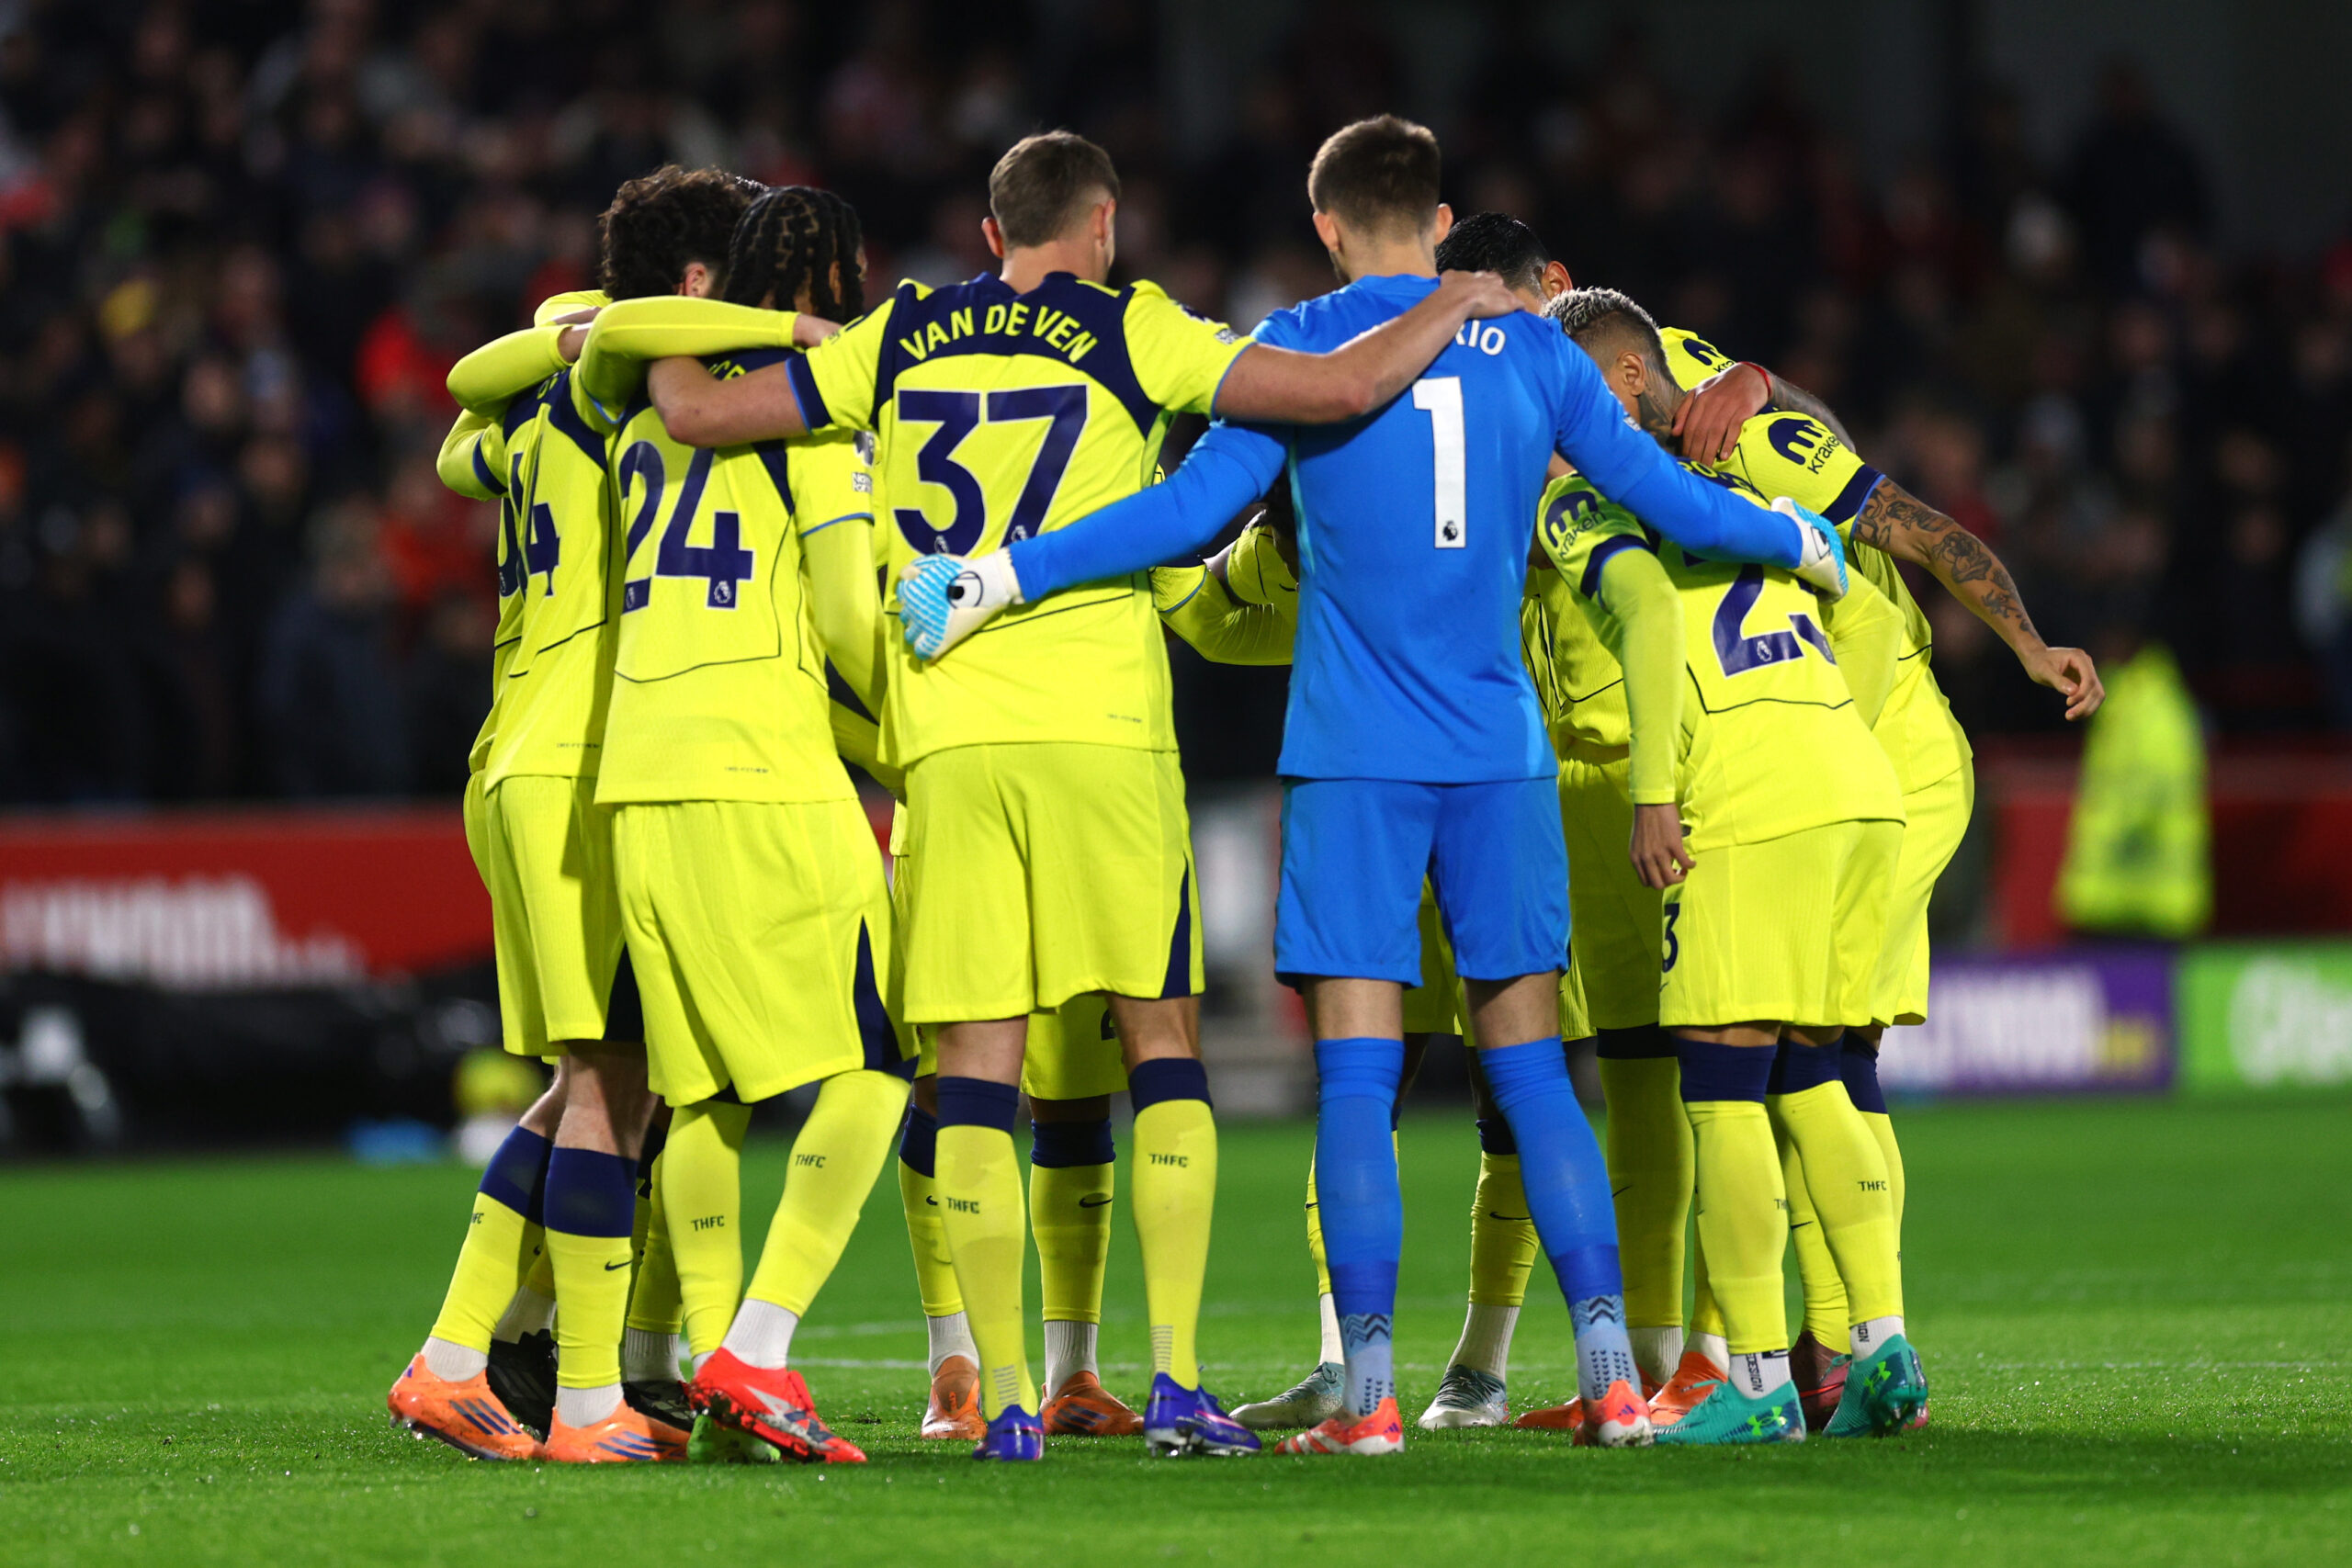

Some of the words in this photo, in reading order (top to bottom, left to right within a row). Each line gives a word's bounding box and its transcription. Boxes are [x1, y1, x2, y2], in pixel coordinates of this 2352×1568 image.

[899, 306, 975, 361] VAN
[983, 301, 1030, 336] DE
[1032, 305, 1098, 363] VEN
[893, 384, 1089, 557] 37
[1411, 376, 1466, 549] 1
[618, 440, 754, 615] 24
[795, 1154, 827, 1168] THFC
[1148, 1153, 1188, 1168] THFC
[1857, 1180, 1887, 1191] THFC
[945, 1197, 980, 1214] THFC
[691, 1215, 725, 1232] THFC
